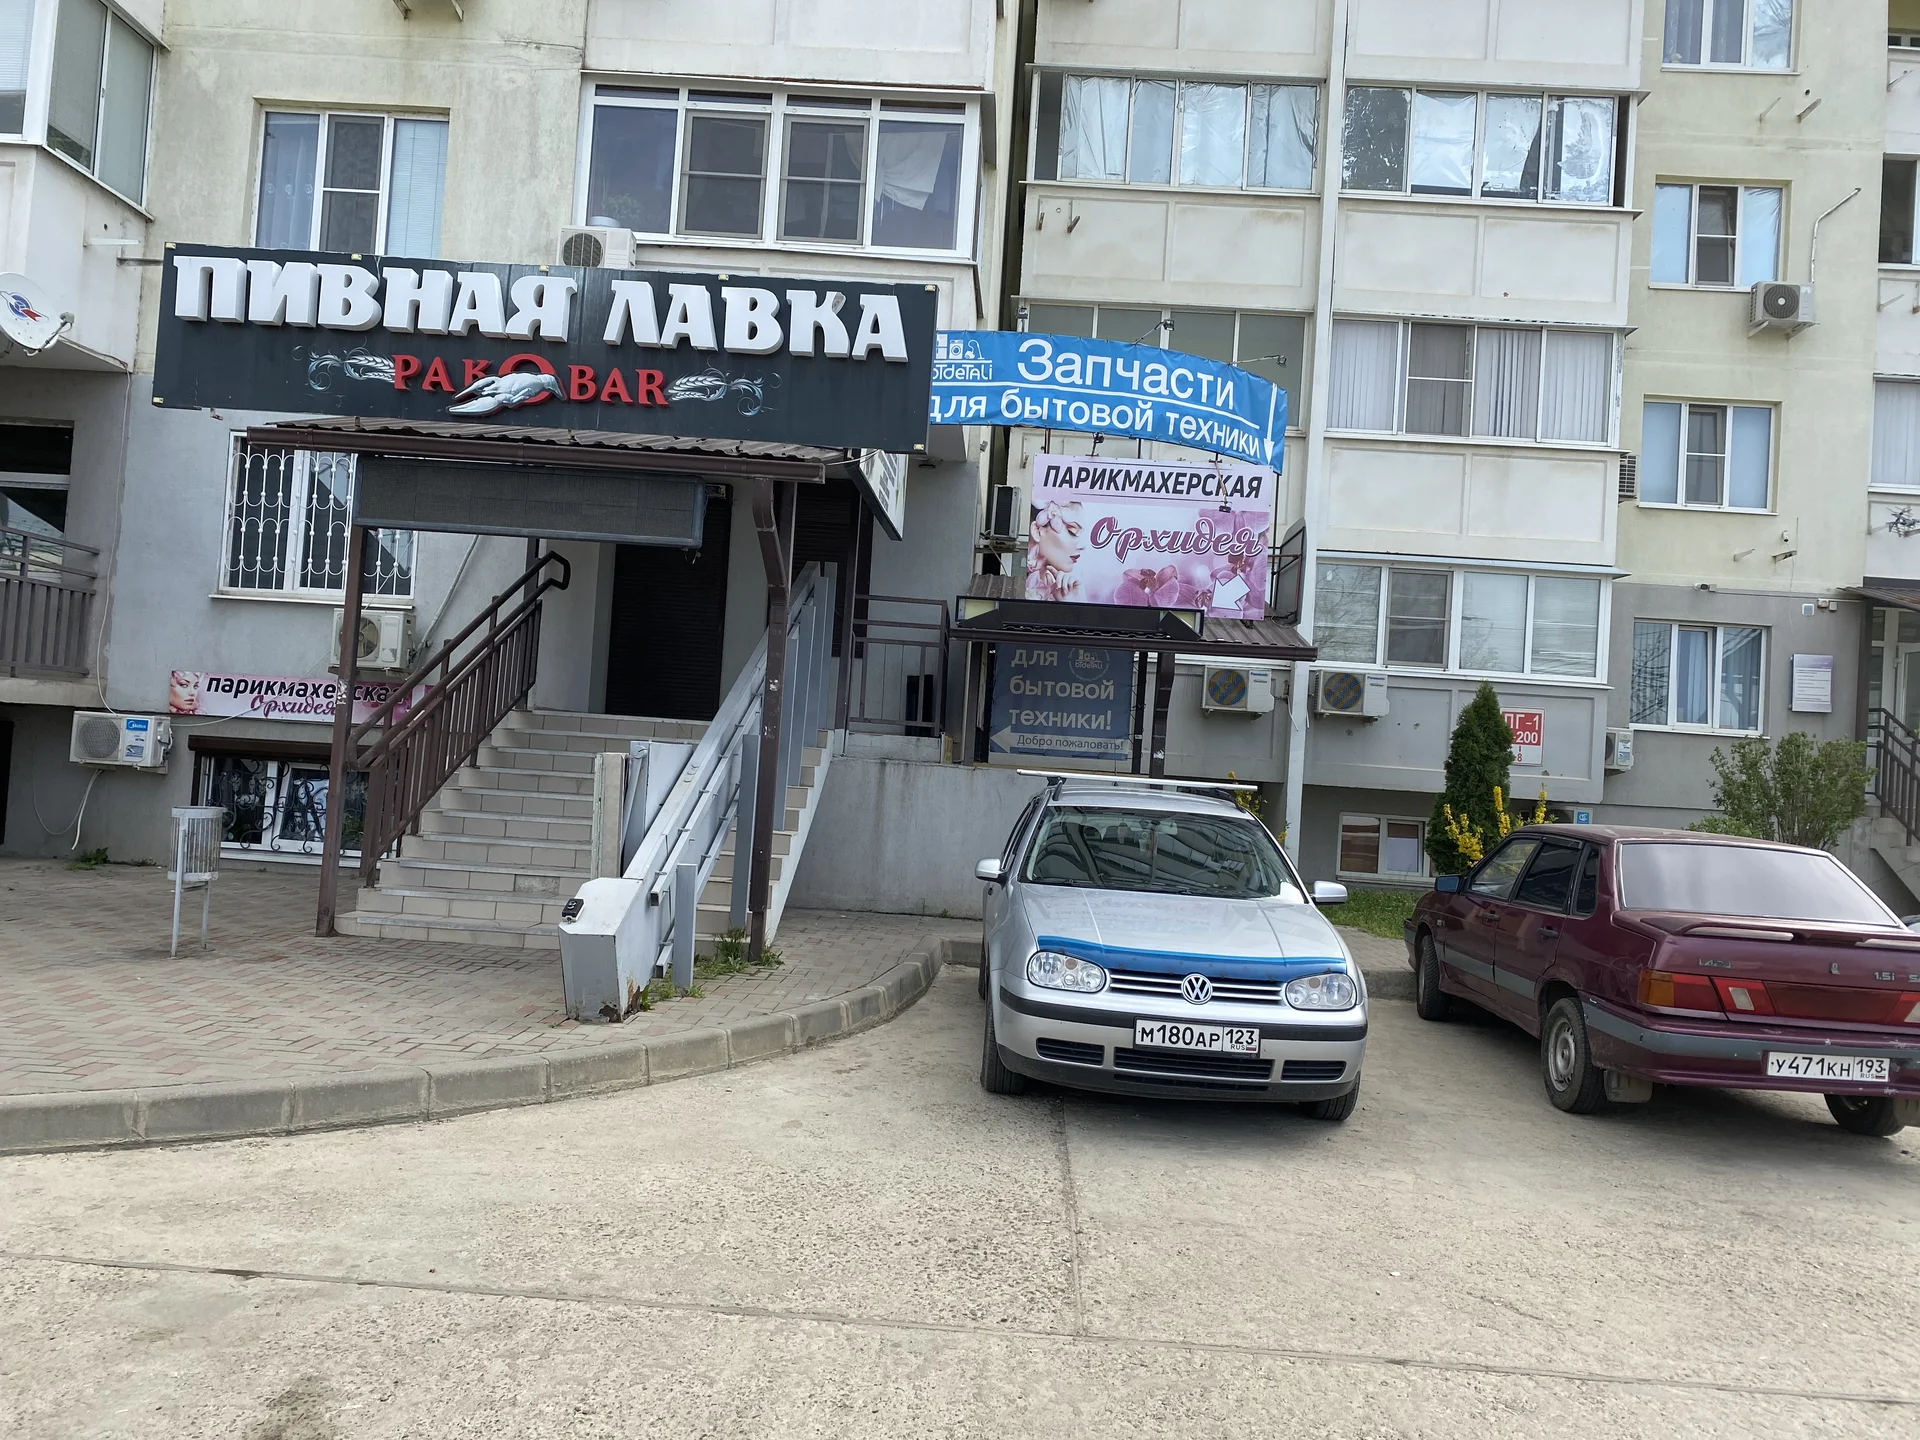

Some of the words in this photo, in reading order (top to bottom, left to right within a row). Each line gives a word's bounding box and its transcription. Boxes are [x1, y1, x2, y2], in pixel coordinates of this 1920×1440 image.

[173, 256, 576, 342] ПИВНАЯ
[604, 279, 908, 362] ЛАВКА
[1018, 339, 1234, 410] Запчасти
[930, 395, 987, 422] для
[1001, 388, 1152, 432] бытовой
[1166, 411, 1261, 459] техники
[1043, 465, 1263, 498] ПАРИКМАХЕРСКАЯ
[1090, 513, 1263, 563] Орхидея
[1011, 650, 1058, 668] для
[206, 677, 404, 704] парикмахеска
[1009, 674, 1115, 700] бытовой
[1009, 709, 1112, 730] техники!
[1017, 735, 1052, 748] Добро
[1055, 738, 1124, 750] пожаловать!
[1513, 731, 1538, 743] -200
[1873, 971, 1895, 981] 1.5i
[1140, 1024, 1220, 1048] М180АР
[1225, 1028, 1255, 1044] 123
[1775, 1056, 1851, 1077] У471КН
[1856, 1059, 1884, 1073] 193
